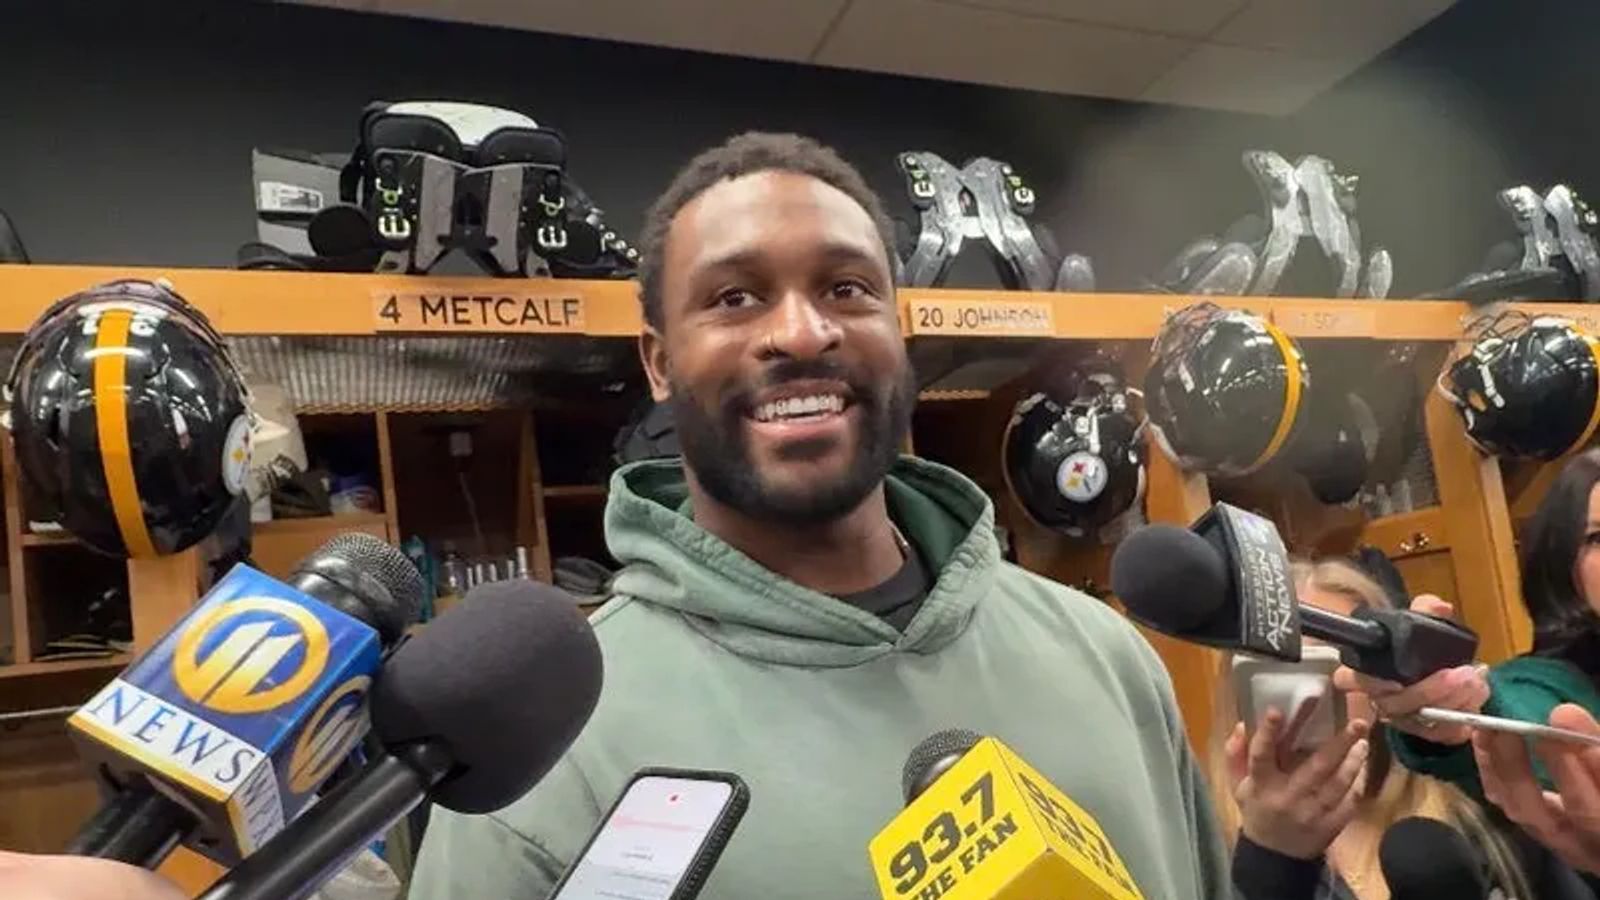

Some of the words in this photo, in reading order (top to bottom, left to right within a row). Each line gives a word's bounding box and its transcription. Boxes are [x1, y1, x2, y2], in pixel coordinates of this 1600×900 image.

[380, 295, 402, 324] 4
[419, 295, 579, 326] METCALF
[918, 307, 944, 328] 20
[88, 685, 255, 784] NEWS
[889, 771, 995, 895] 93.7
[958, 812, 1019, 875] FAN
